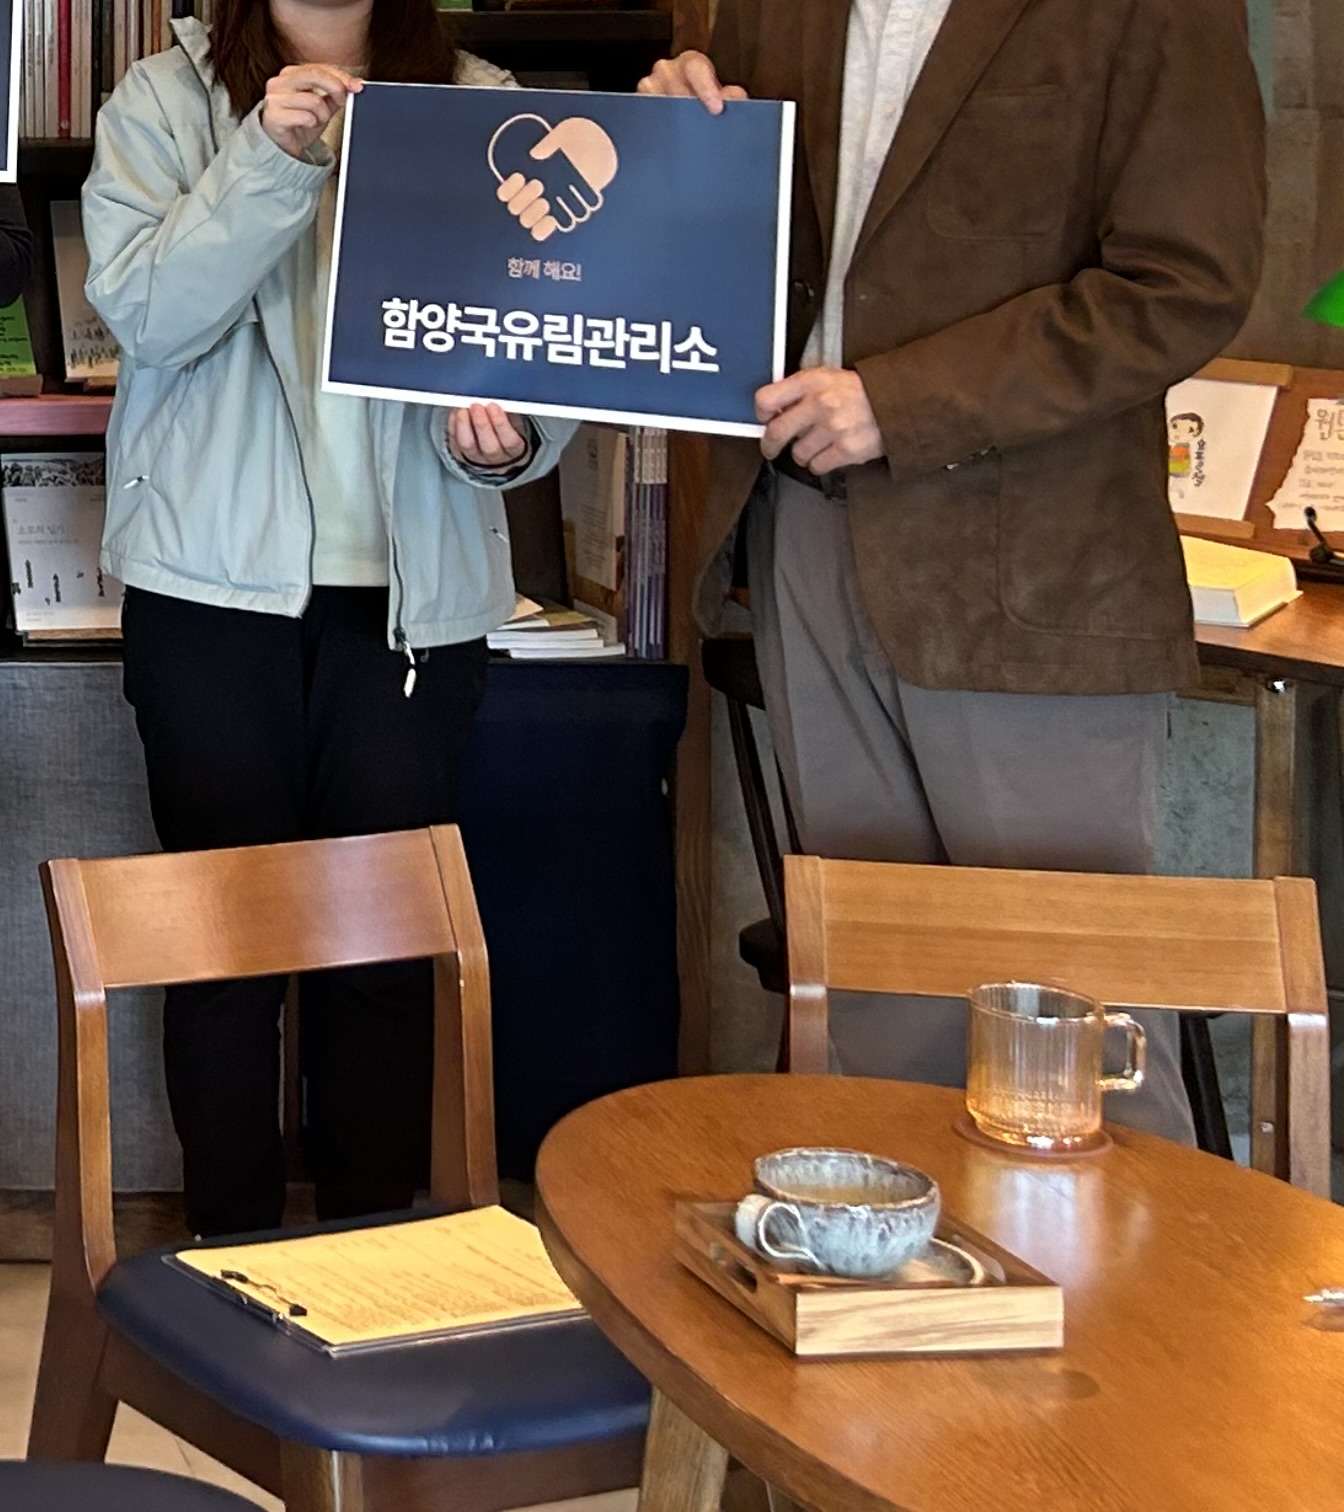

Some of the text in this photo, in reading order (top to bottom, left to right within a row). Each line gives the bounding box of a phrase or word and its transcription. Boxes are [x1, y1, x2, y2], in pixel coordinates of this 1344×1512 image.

[507, 257, 582, 282] 함께 해요!
[381, 296, 720, 374] 함양국유림관리소
